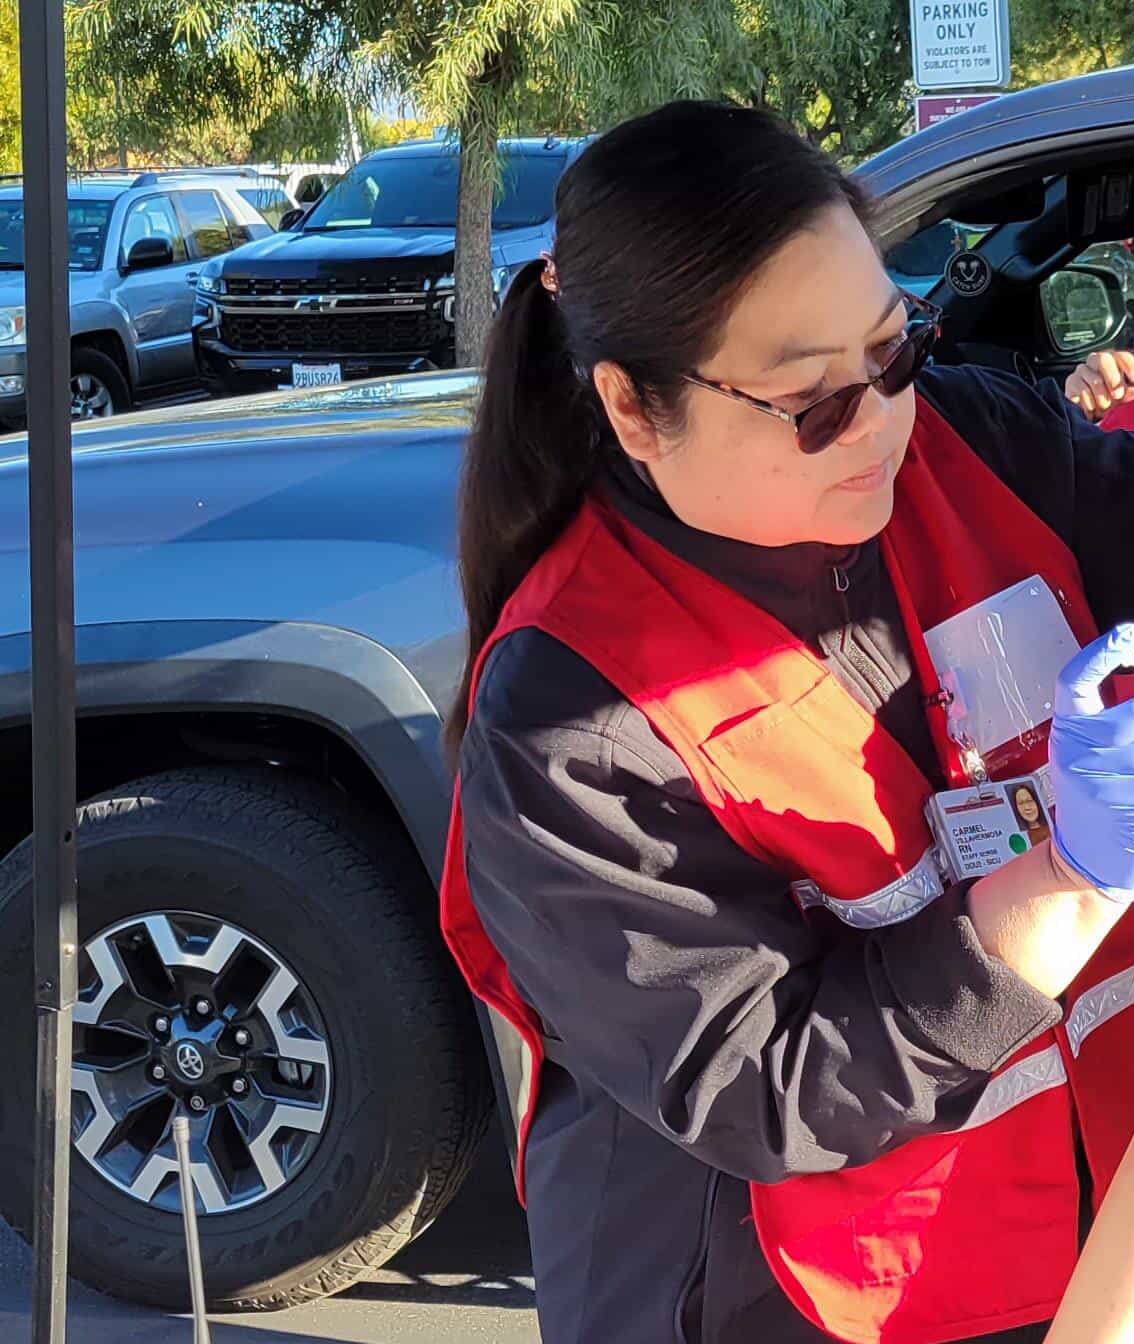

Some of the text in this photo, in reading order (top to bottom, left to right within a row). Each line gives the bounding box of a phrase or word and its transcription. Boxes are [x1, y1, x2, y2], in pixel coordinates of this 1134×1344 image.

[923, 2, 988, 21] PARKING
[936, 23, 976, 40] ONLY
[926, 44, 987, 56] VIOLATORS ARE
[924, 59, 959, 70] SUBJECT
[961, 58, 972, 68] TO
[959, 844, 972, 854] RN
